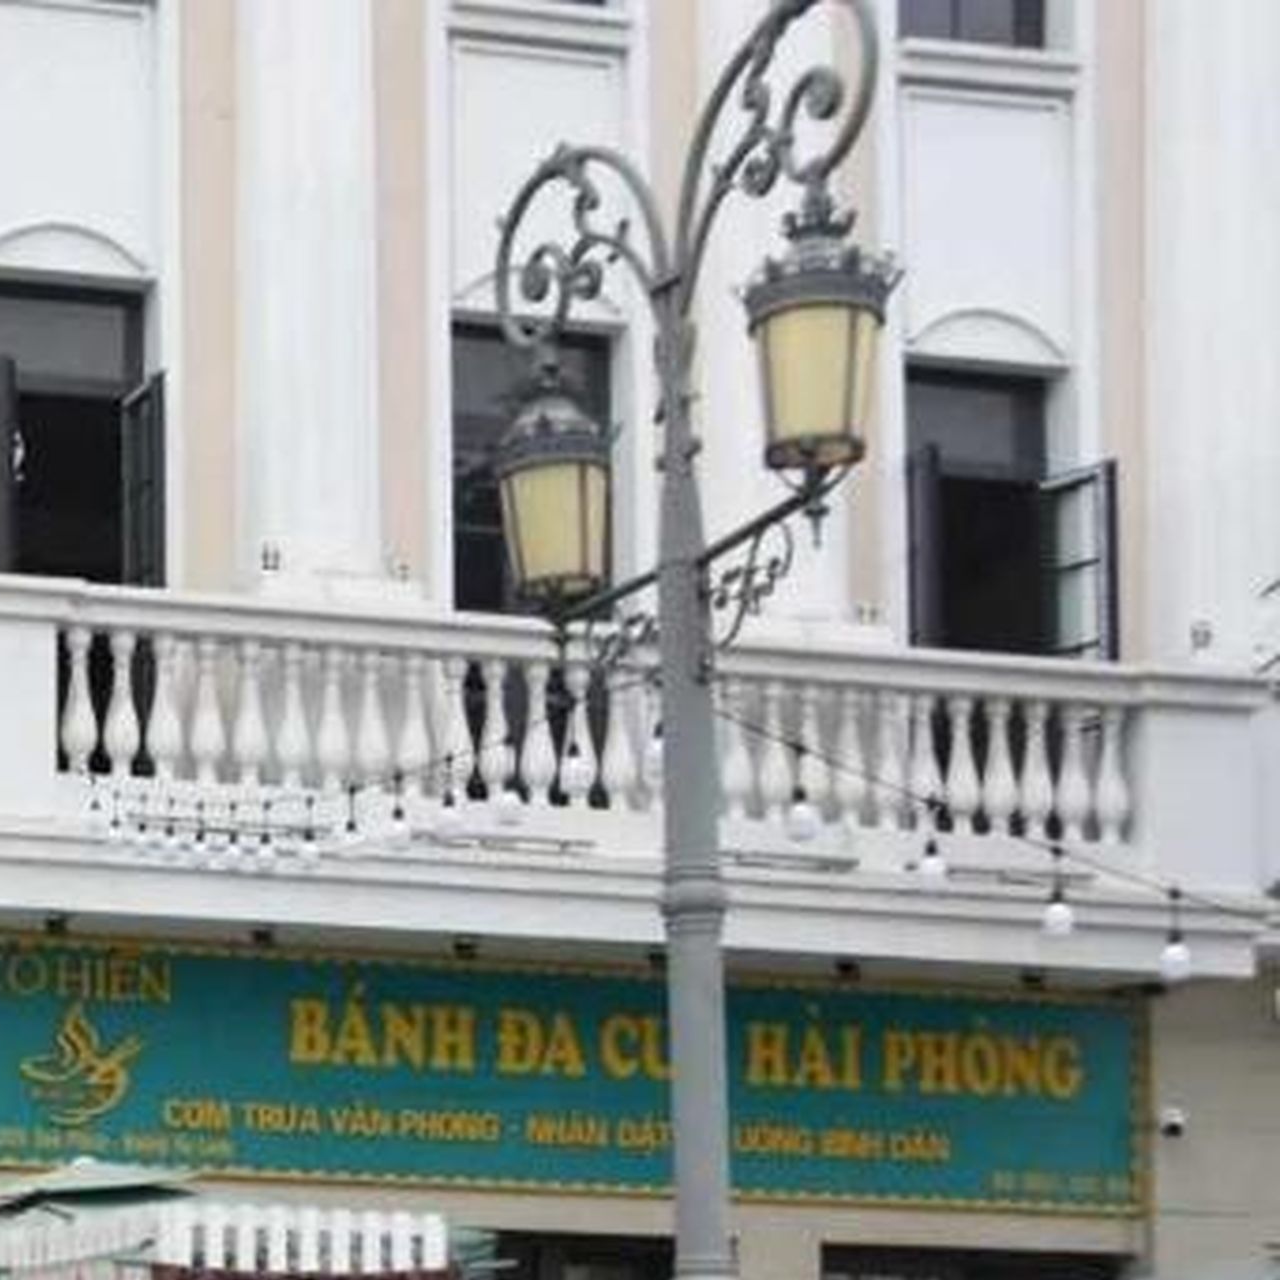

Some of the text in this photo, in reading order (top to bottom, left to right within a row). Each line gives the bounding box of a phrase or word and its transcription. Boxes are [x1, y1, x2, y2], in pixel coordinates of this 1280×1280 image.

[288, 981, 476, 1072] BÁNH
[495, 1007, 588, 1079] ĐA
[599, 1012, 679, 1081] CU
[881, 1015, 1083, 1099] PHÒNG
